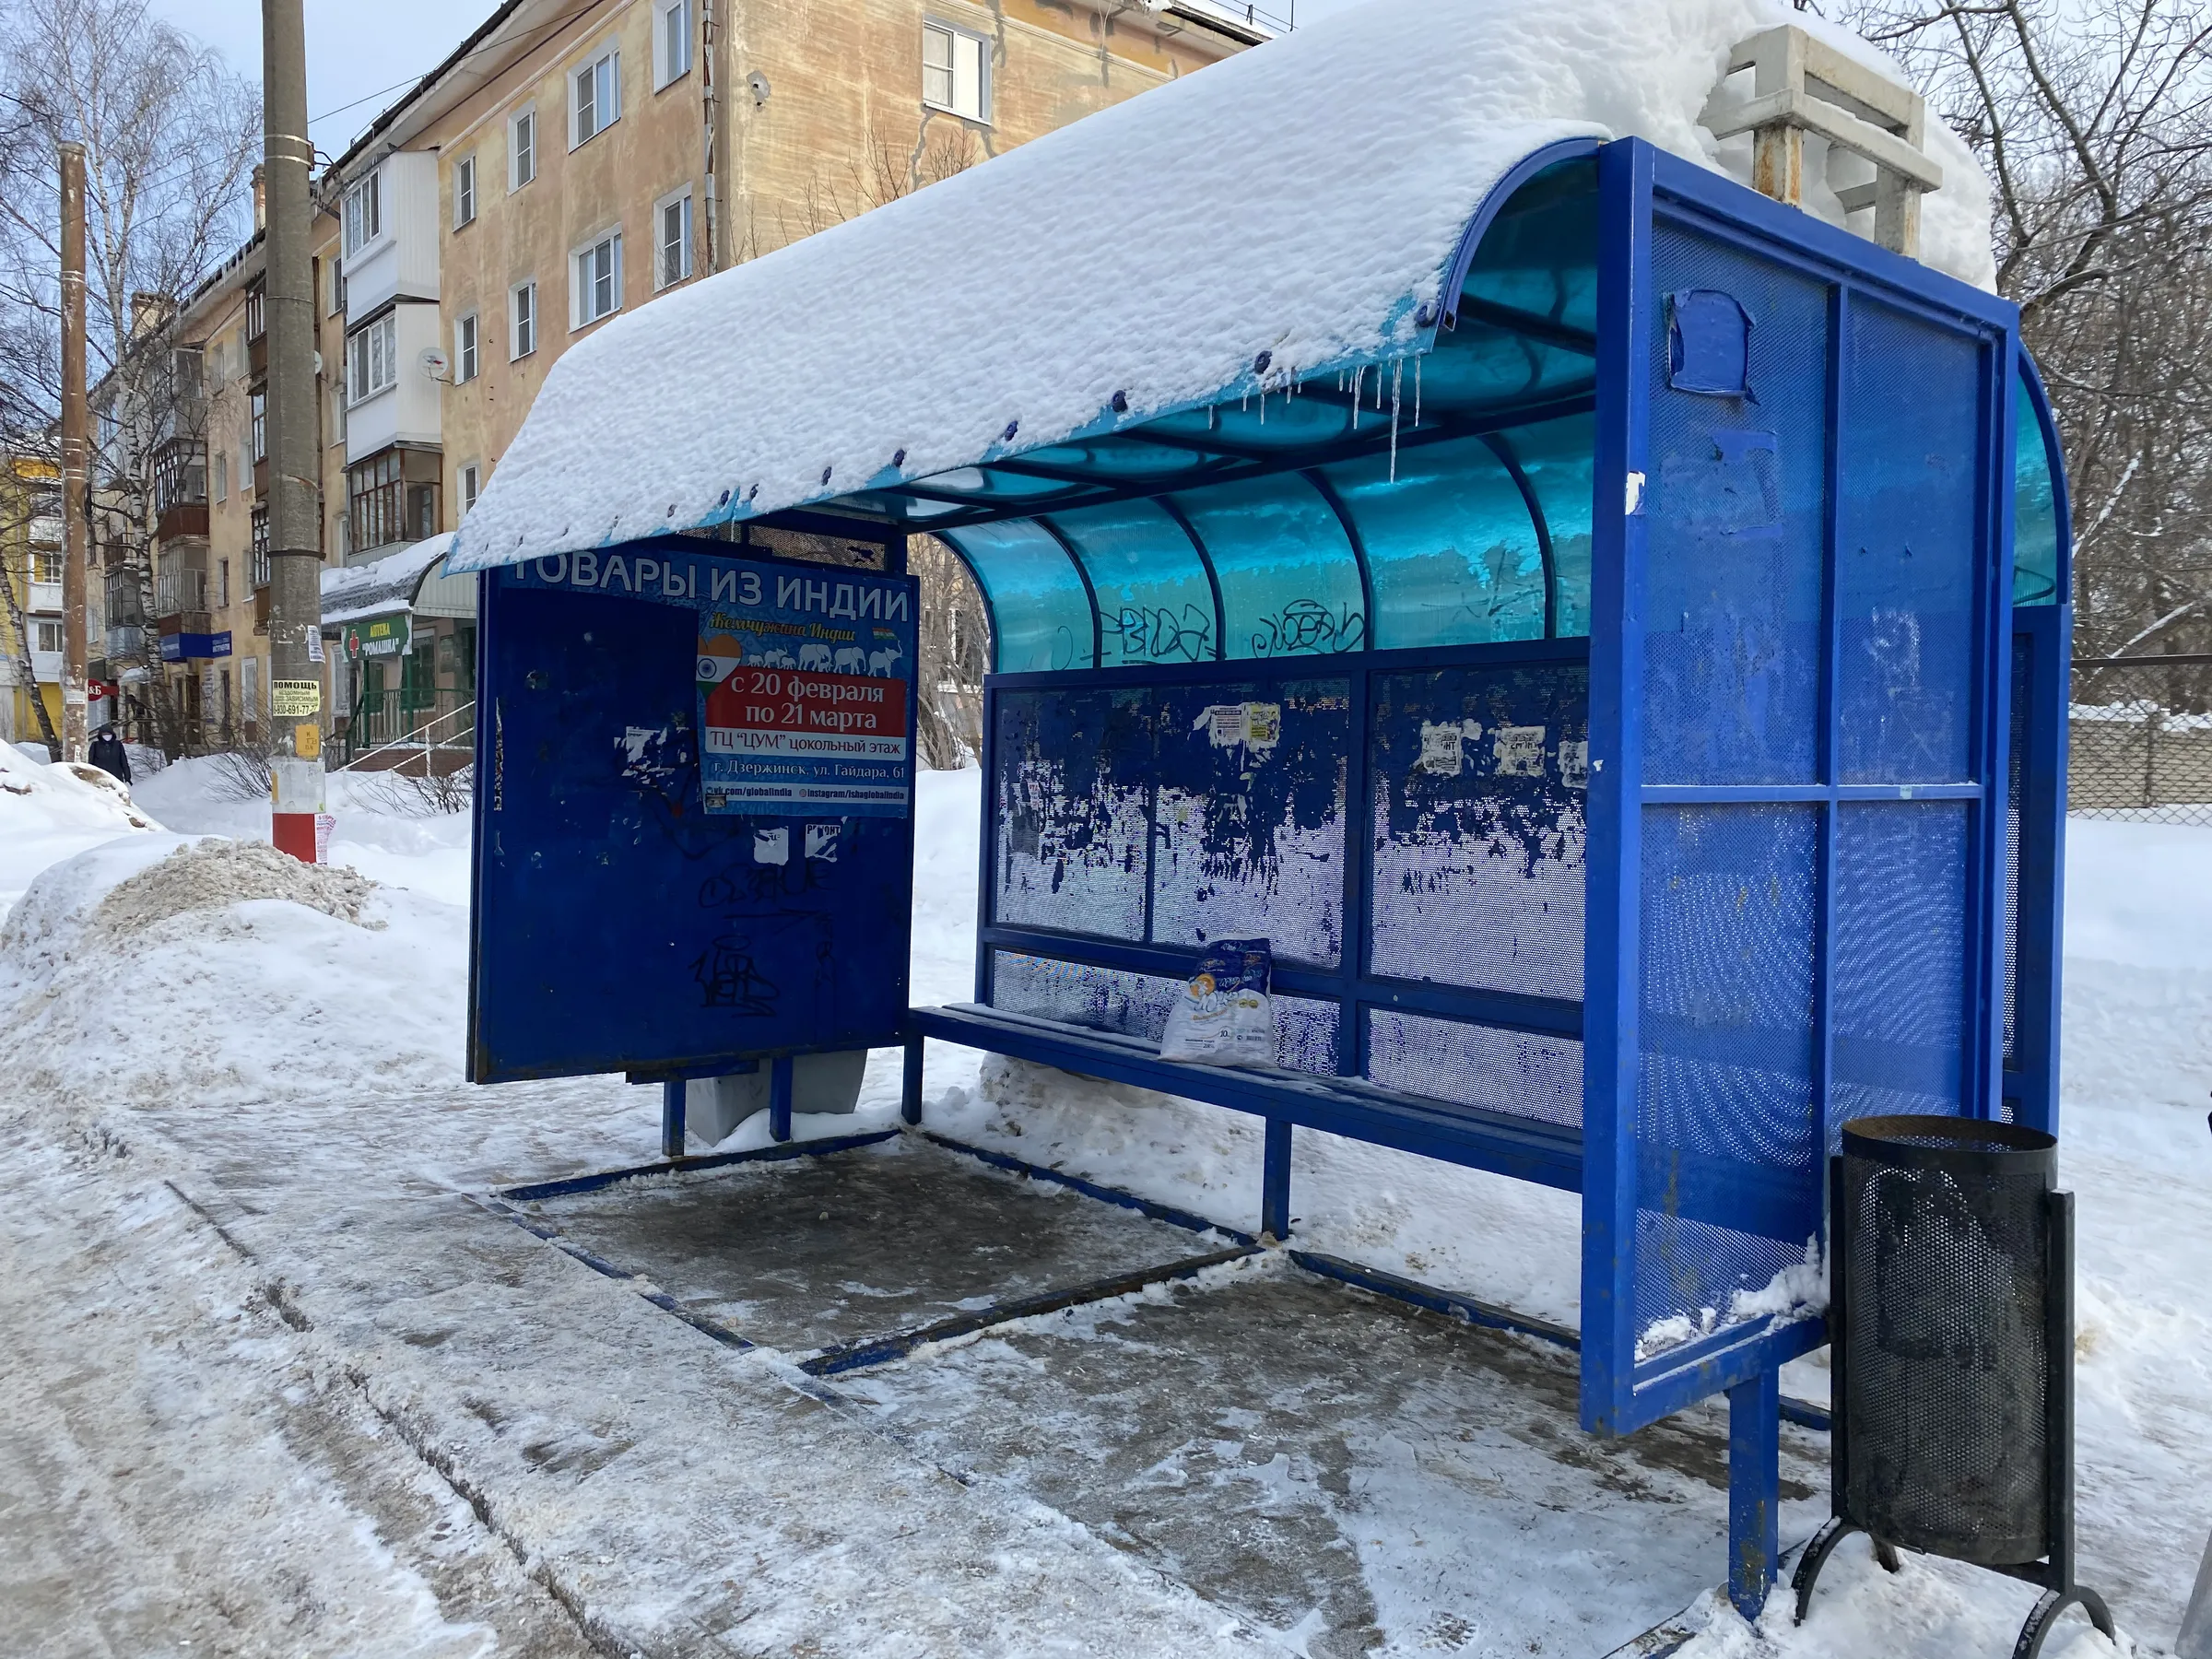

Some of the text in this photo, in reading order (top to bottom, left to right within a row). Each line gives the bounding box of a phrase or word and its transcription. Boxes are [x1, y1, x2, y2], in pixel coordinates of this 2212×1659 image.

[711, 568, 762, 606] ИЗ
[777, 575, 908, 622] ИНДИИ
[370, 622, 391, 638] АПТЕКА
[710, 611, 856, 644] Жемчужина Индии
[88, 685, 101, 695] &Б
[274, 681, 317, 690] ПОМОЩЬ
[731, 672, 885, 705] с 20 февраля
[746, 702, 877, 732] по 21 марта
[711, 731, 734, 748] ТЦ
[789, 738, 865, 754] цокольный
[868, 742, 901, 755] этаж
[714, 762, 724, 772] г.
[727, 760, 809, 776] Дзержинск,
[813, 766, 830, 778] ул.
[892, 766, 905, 778] 61
[713, 786, 793, 797] vkcom/globalindia
